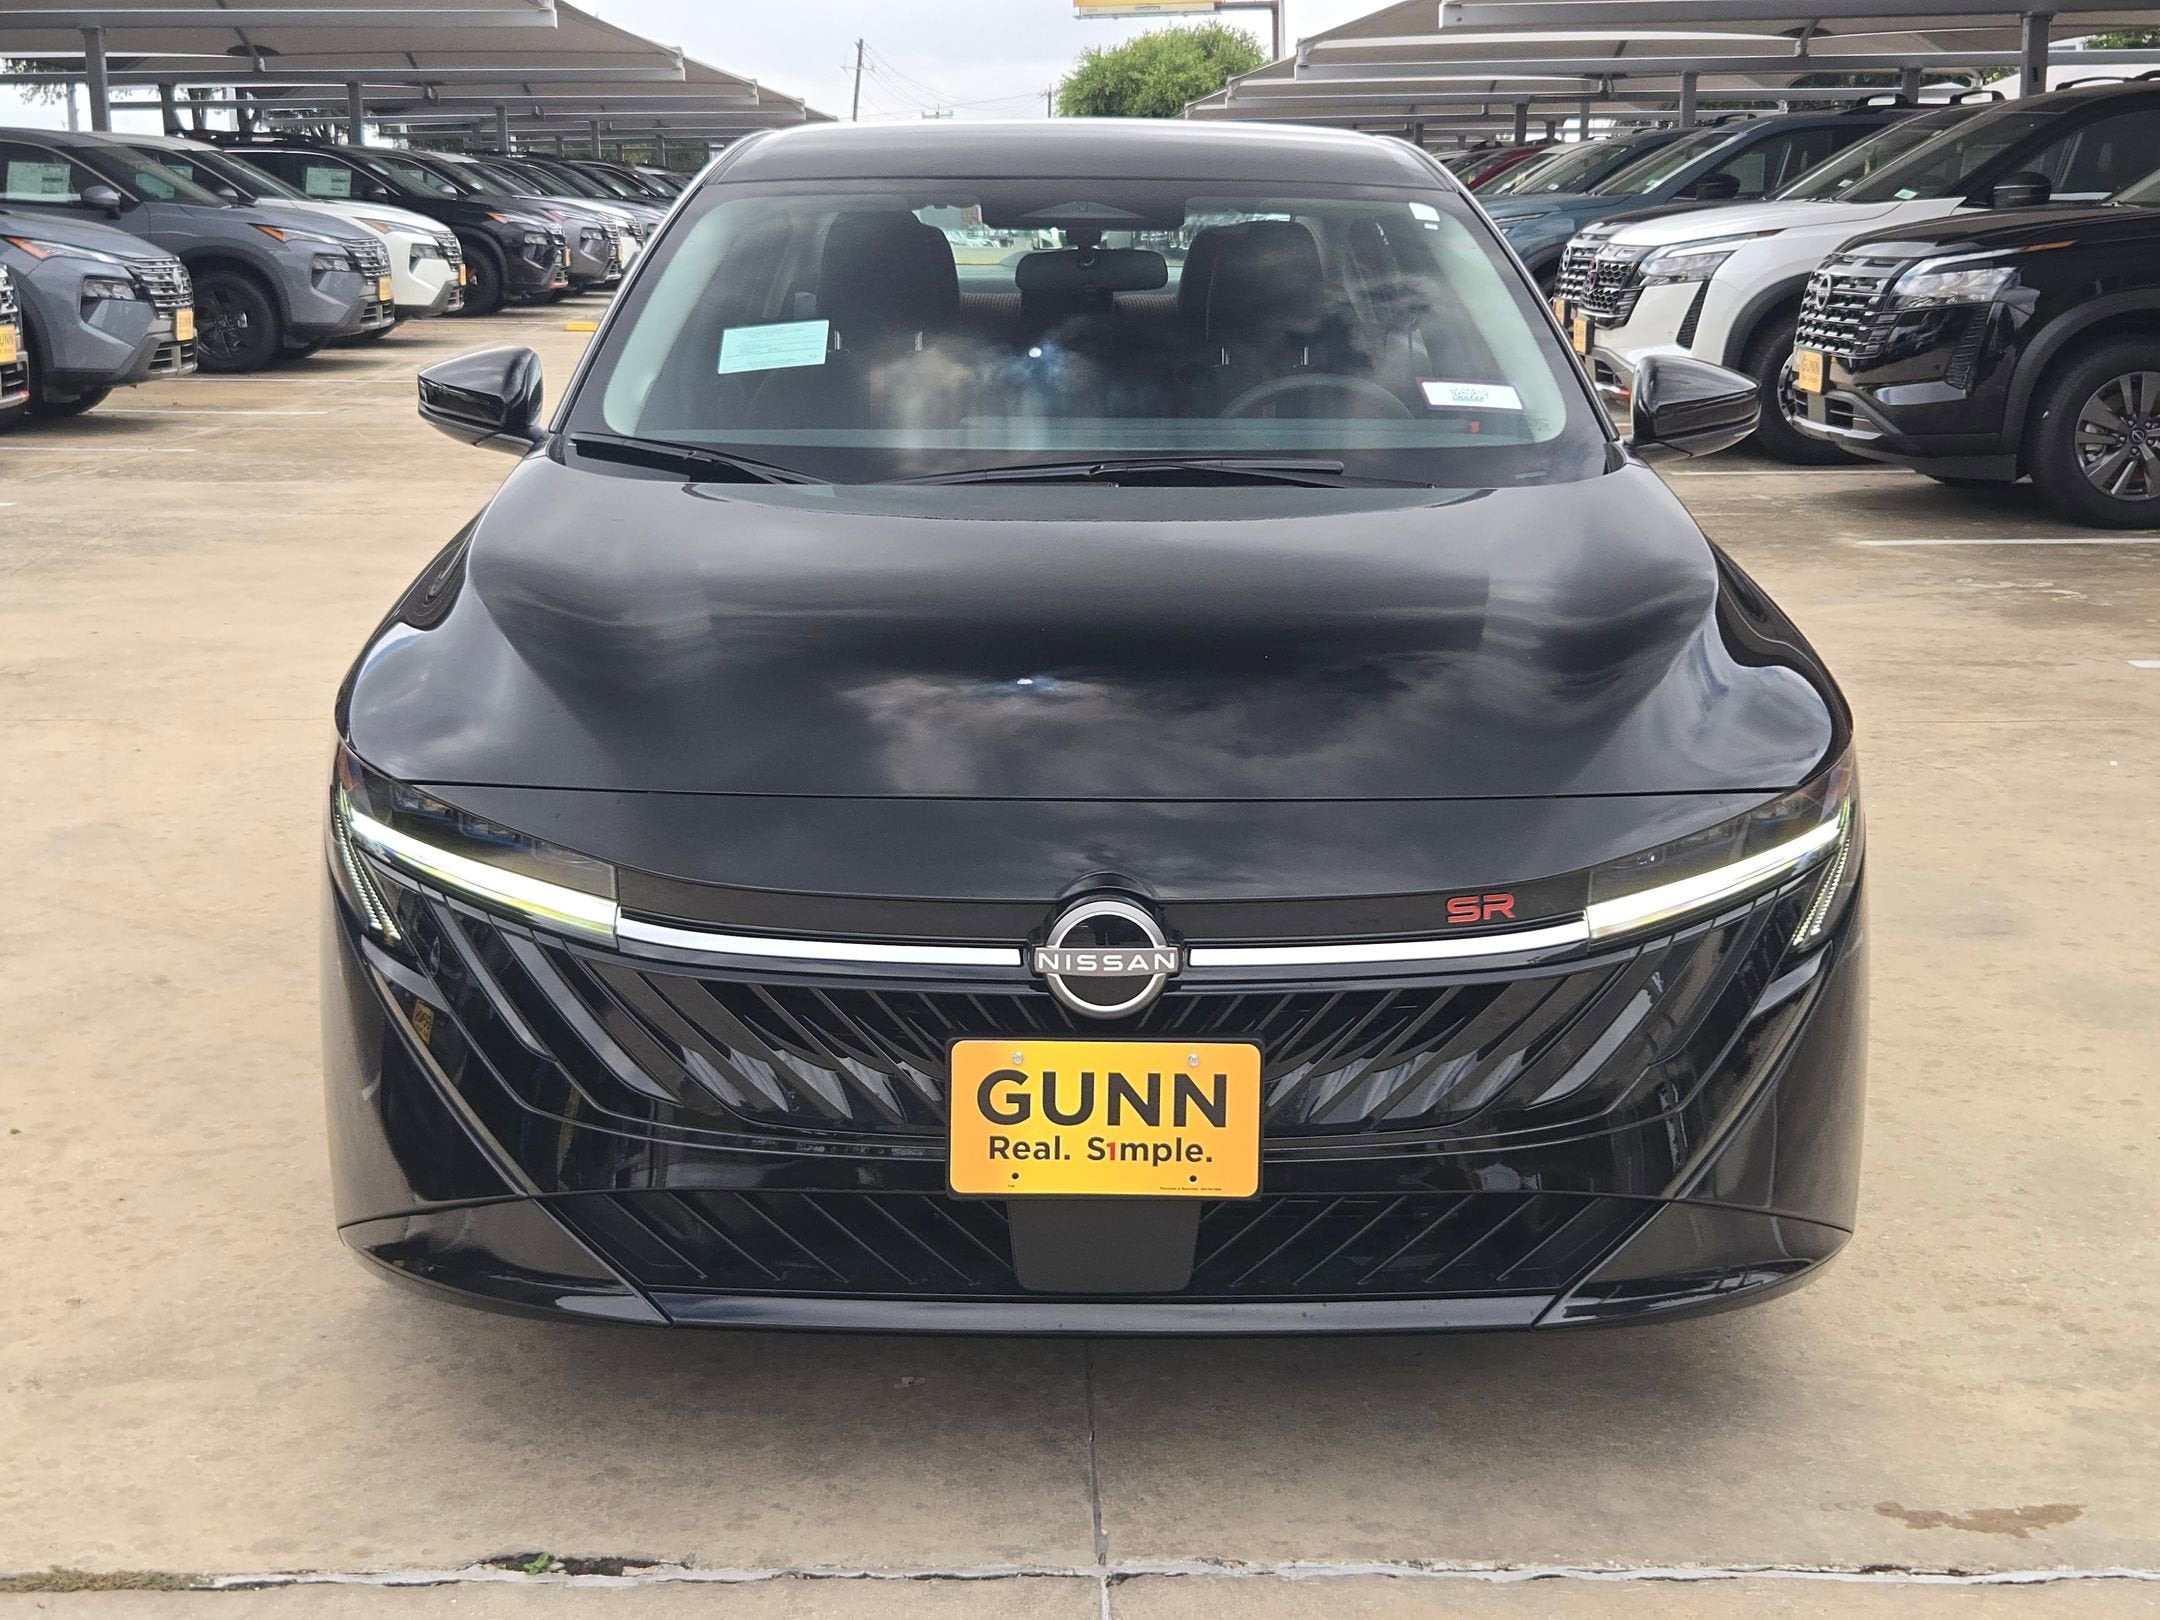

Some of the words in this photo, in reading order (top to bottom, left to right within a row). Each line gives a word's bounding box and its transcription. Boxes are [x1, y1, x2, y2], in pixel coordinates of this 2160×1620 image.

[1446, 893, 1516, 923] SR
[1038, 952, 1175, 971] NISSAN
[977, 1069, 1227, 1128] GUNN
[989, 1135, 1071, 1160] Real.
